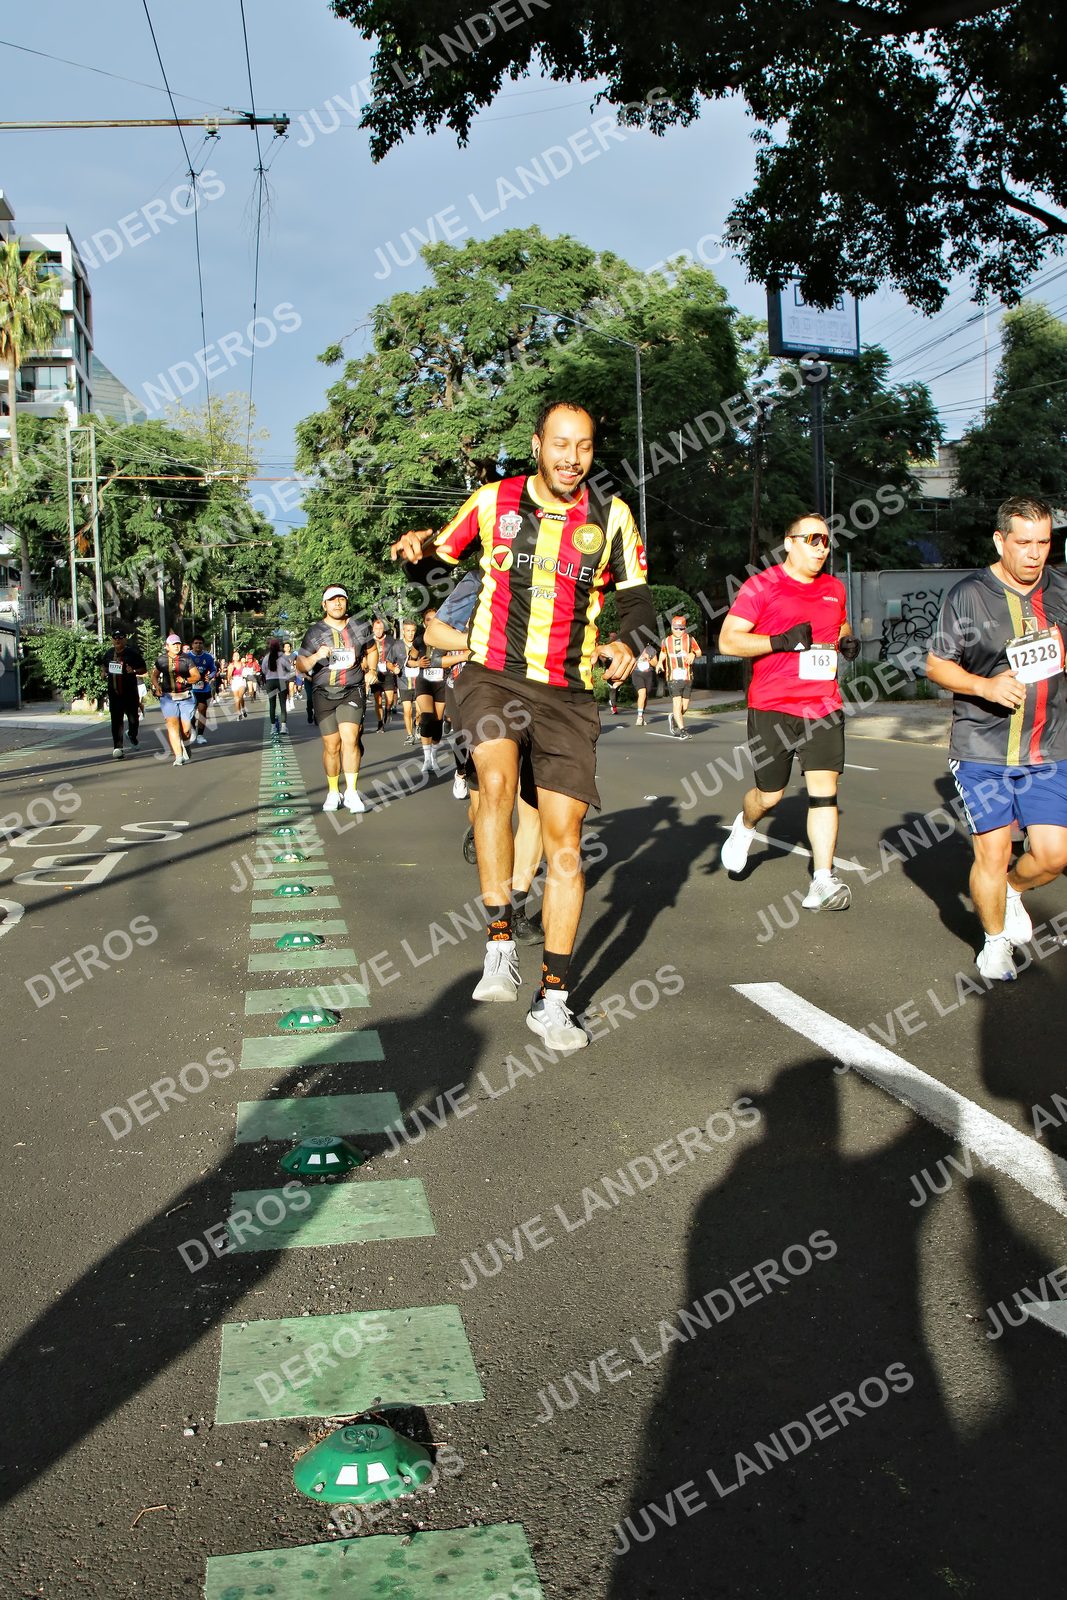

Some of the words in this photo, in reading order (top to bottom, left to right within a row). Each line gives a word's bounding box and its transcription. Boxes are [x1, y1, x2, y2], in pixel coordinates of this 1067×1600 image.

[902, 588, 944, 604] TOY
[812, 655, 830, 666] 163
[1011, 644, 1058, 669] 12328
